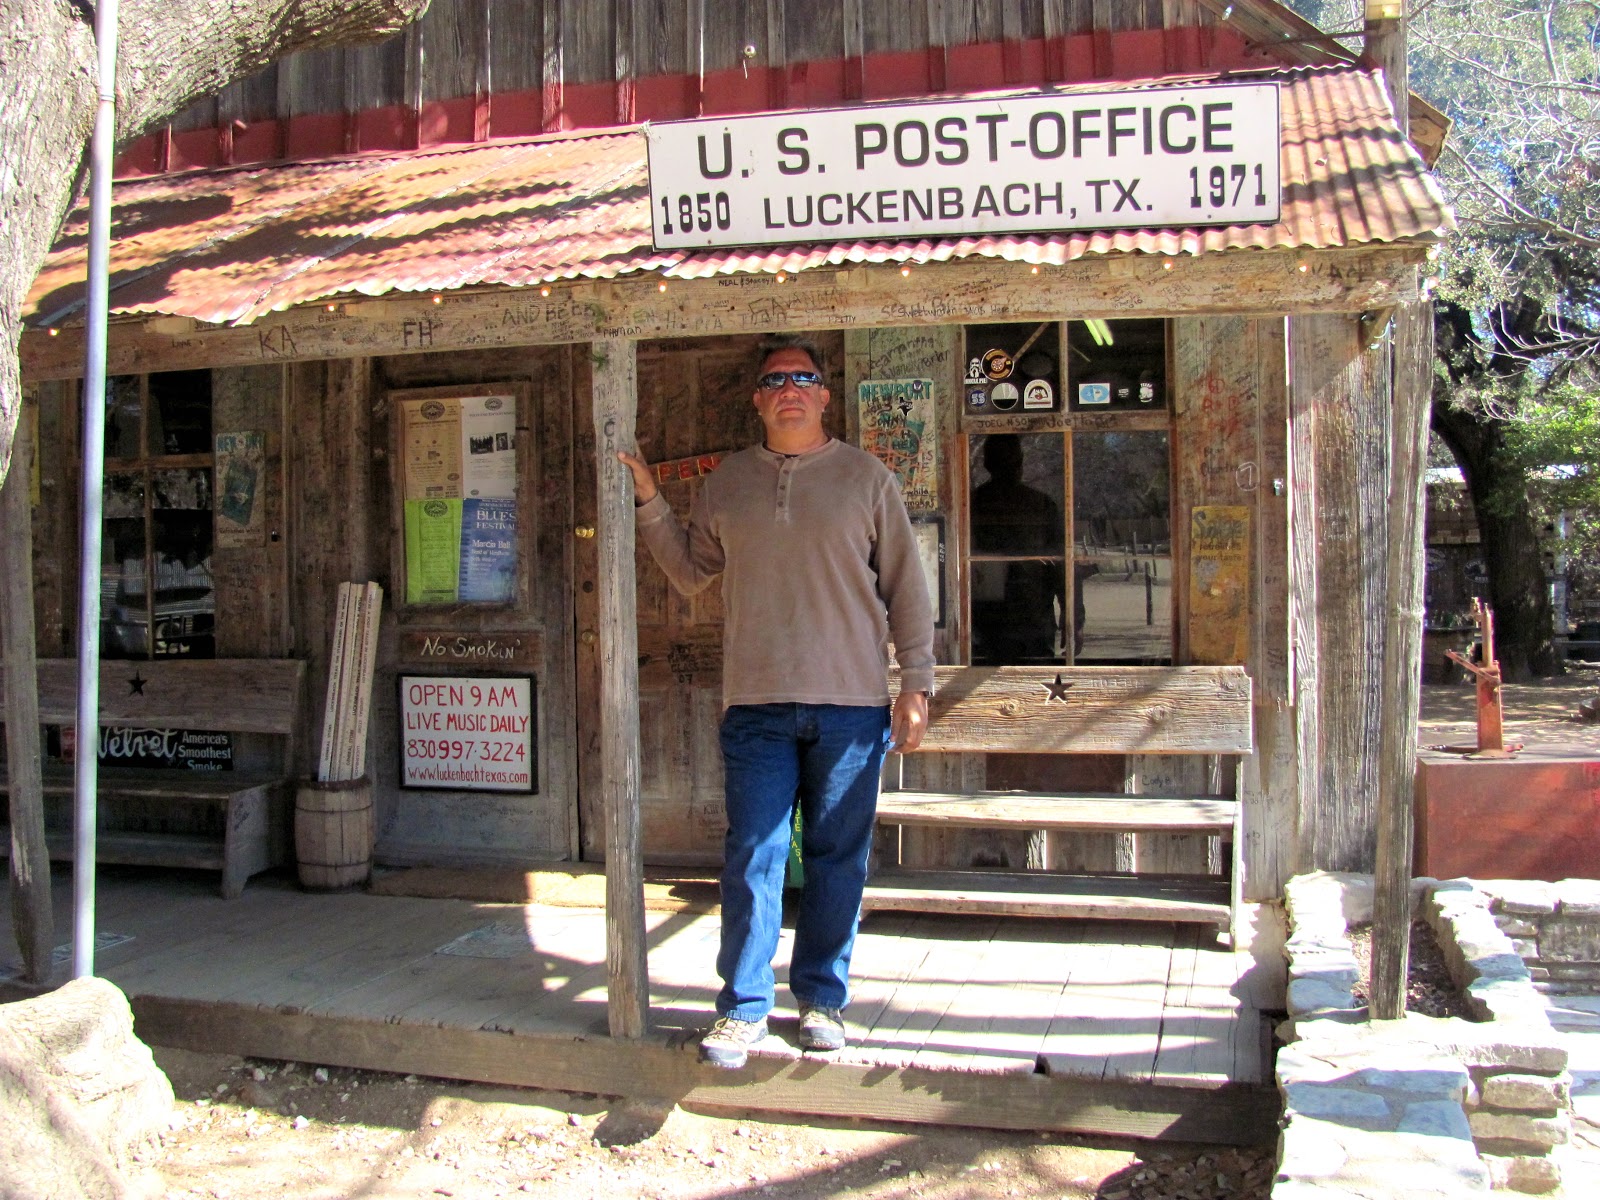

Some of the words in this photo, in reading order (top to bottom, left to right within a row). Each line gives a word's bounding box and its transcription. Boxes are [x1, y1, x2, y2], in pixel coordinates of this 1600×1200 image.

[697, 132, 749, 179] U.
[777, 127, 826, 175] S.
[855, 101, 1234, 170] POST-OFFICE
[661, 191, 731, 235] 1850
[1189, 163, 1267, 208] 1971
[656, 456, 721, 485] PEN
[476, 510, 516, 521] BLUES
[421, 636, 446, 656] No
[409, 684, 463, 706] OPEN
[470, 686, 482, 707] 9
[487, 686, 518, 708] AM
[406, 711, 441, 731] LIVE
[446, 714, 487, 732] MUSIC
[490, 714, 529, 733] DAILY
[182, 731, 228, 745] America's
[178, 745, 232, 759] Smoothest
